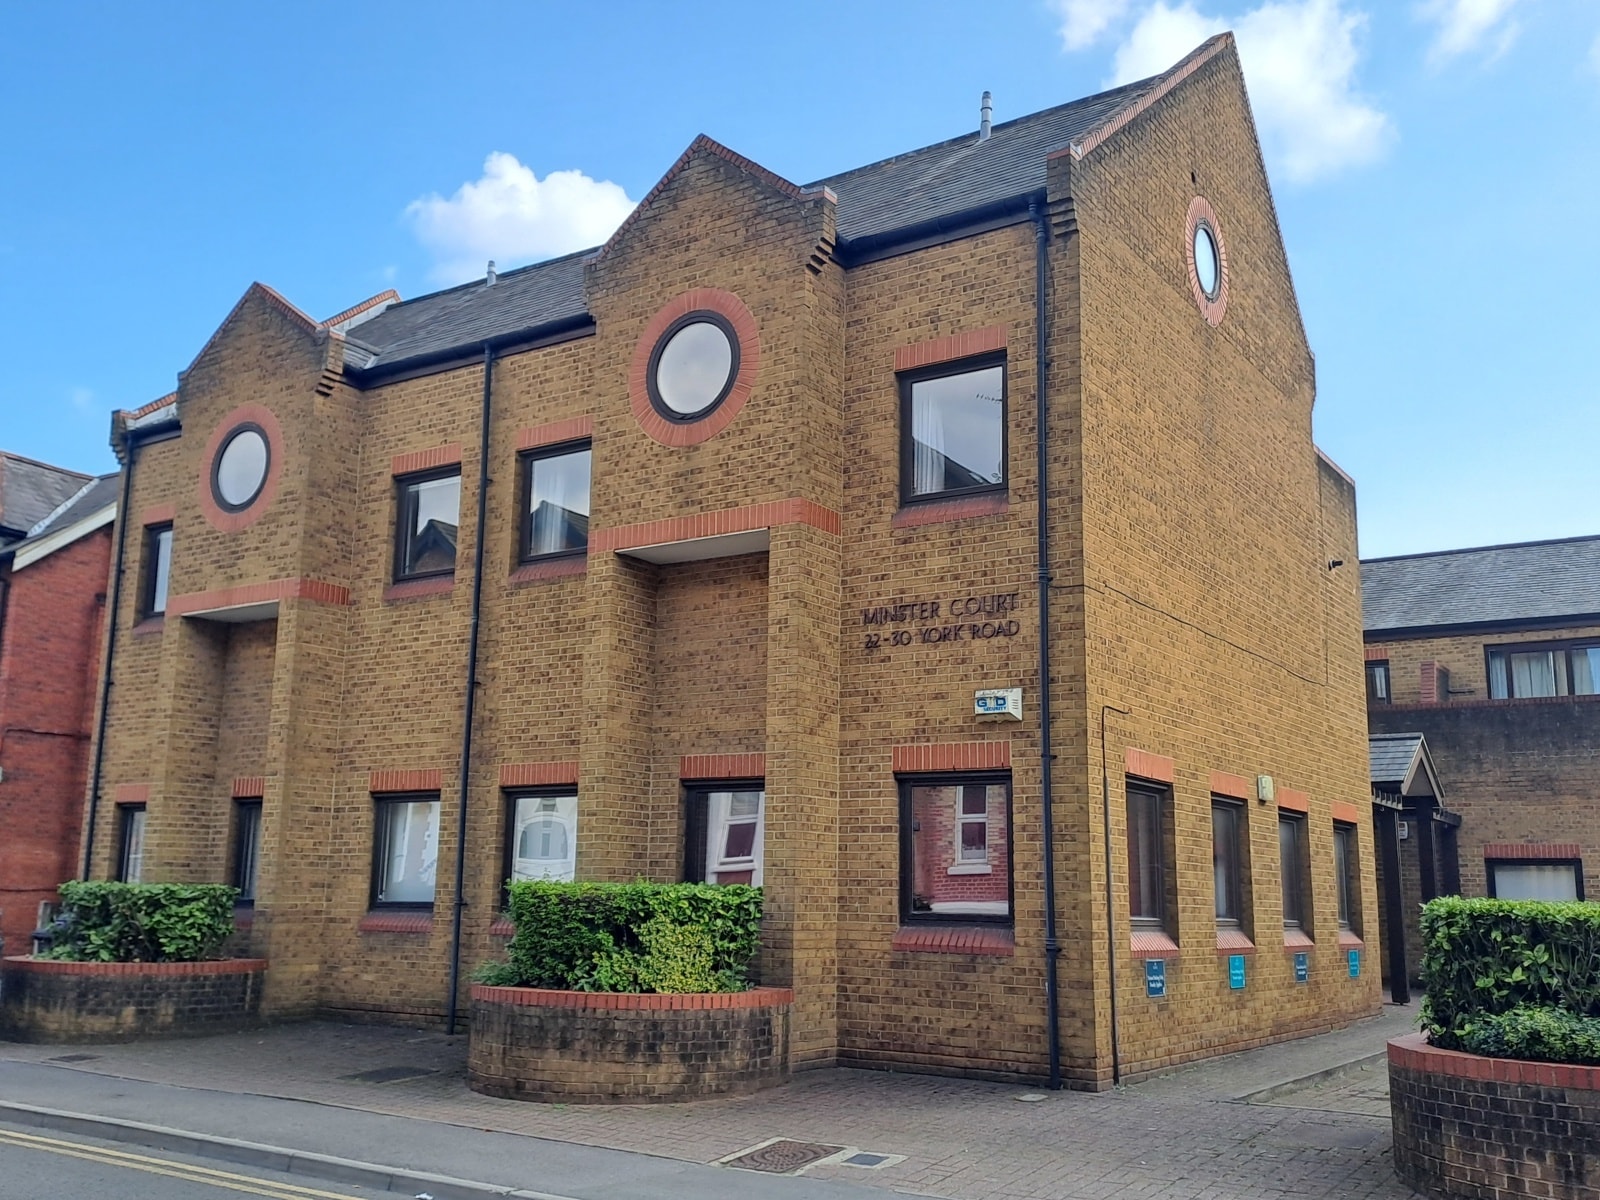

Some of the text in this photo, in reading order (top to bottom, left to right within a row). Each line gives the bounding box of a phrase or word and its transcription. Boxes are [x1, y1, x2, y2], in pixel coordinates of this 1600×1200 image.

[862, 593, 1019, 625] MINSTER COURT
[865, 620, 1020, 649] 22-30 YORK ROAD
